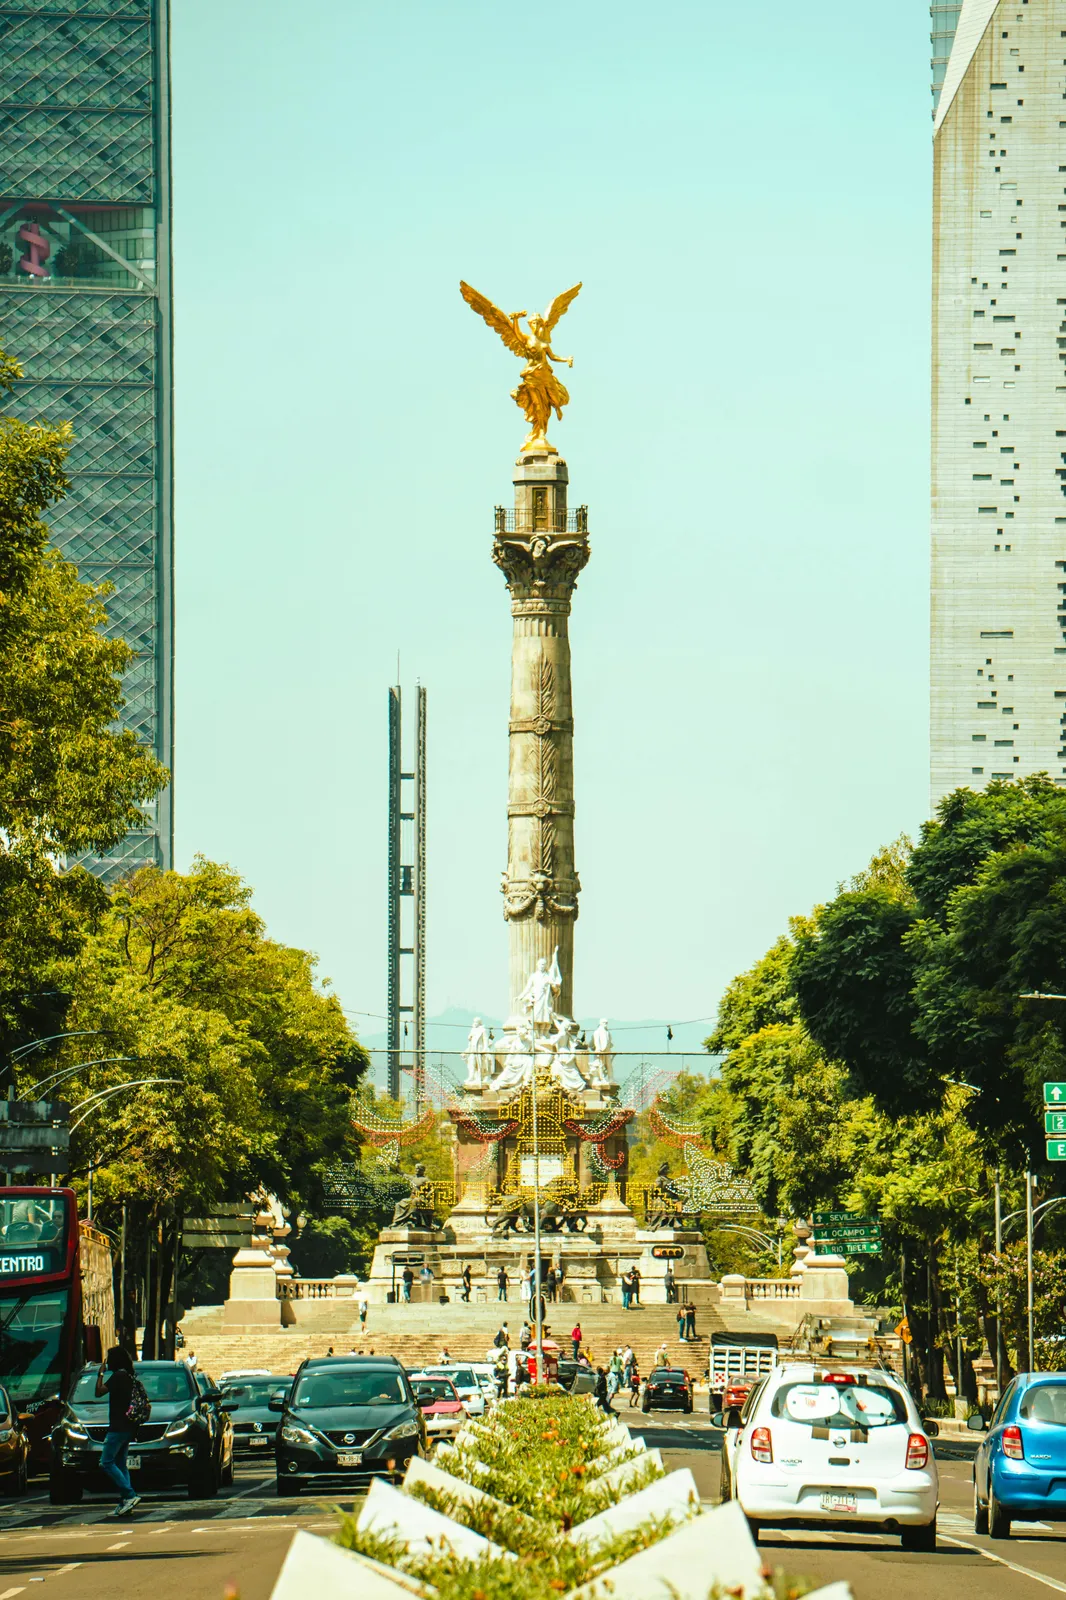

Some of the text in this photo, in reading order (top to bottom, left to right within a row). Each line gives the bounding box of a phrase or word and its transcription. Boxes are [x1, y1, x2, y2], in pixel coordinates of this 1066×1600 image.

[832, 1229, 865, 1237] OCAMPO
[831, 1245, 843, 1253] RIO
[846, 1244, 867, 1252] TIBER
[0, 1256, 44, 1272] ENTRO
